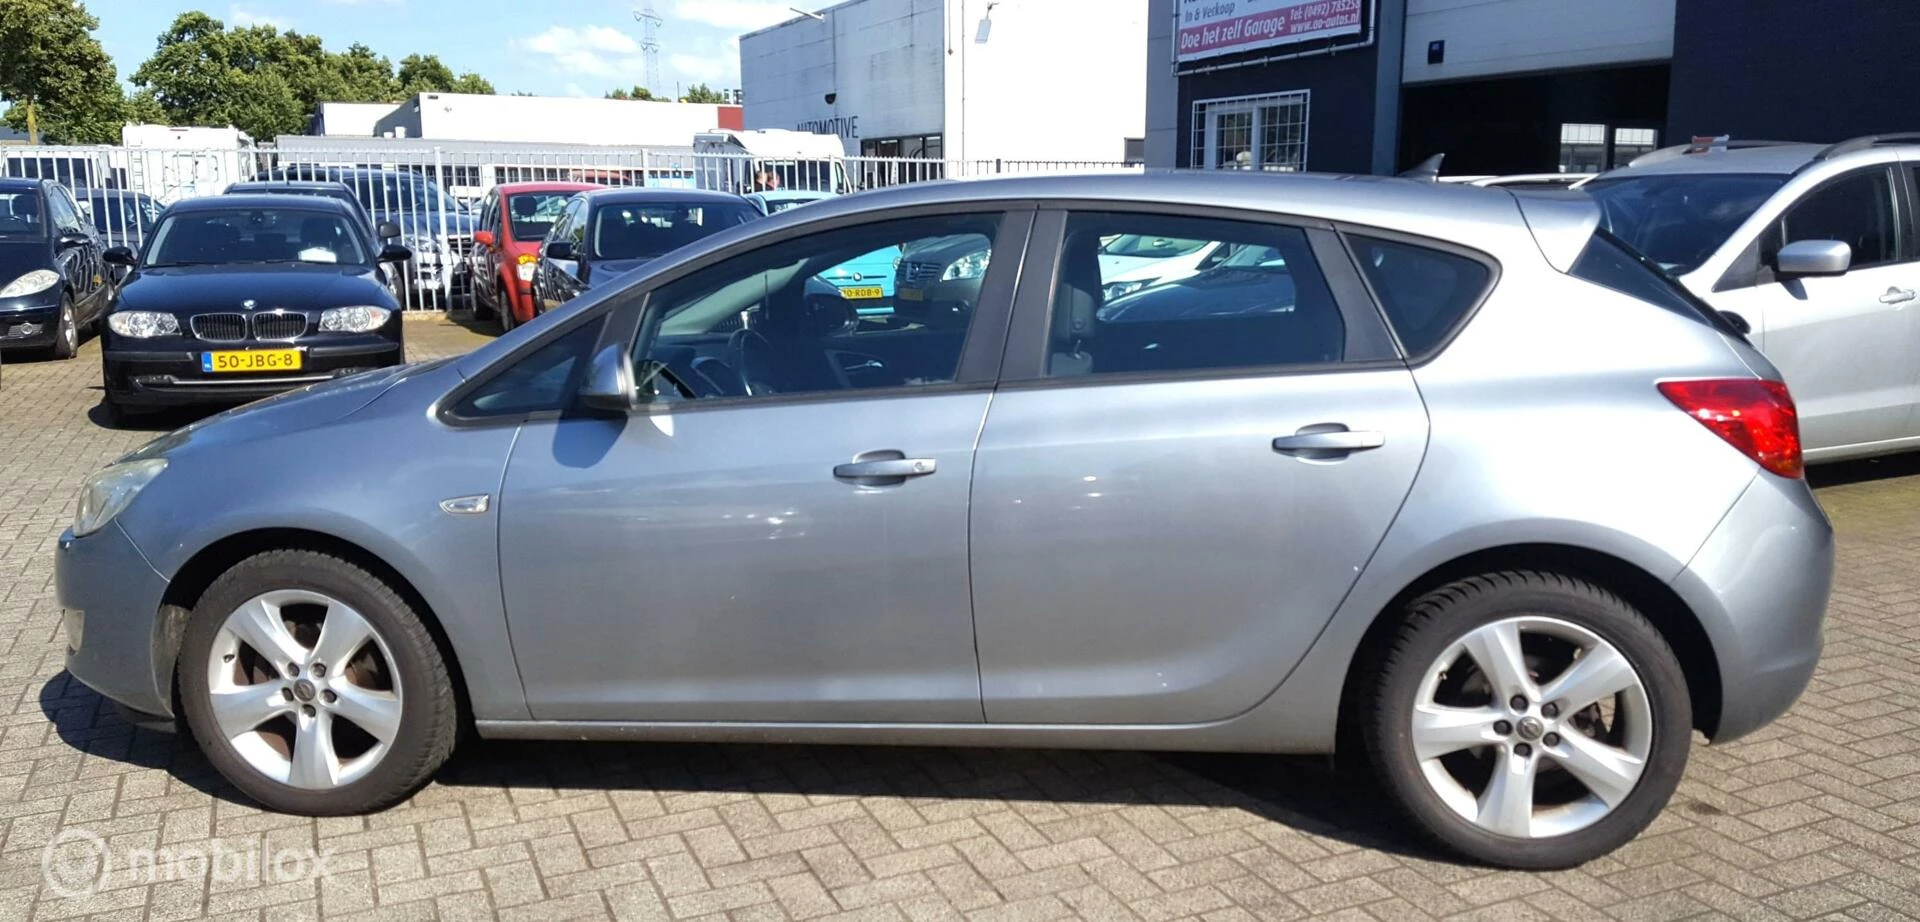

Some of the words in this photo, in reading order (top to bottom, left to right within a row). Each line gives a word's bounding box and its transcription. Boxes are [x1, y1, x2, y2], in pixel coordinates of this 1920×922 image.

[1194, 8, 1200, 20] &
[1202, 2, 1235, 19] Verkoop
[1181, 32, 1200, 49] Doe
[1202, 26, 1220, 46] het
[1221, 19, 1243, 41] zelf
[1244, 16, 1285, 37] Garage
[218, 354, 293, 368] 50-JBG-8
